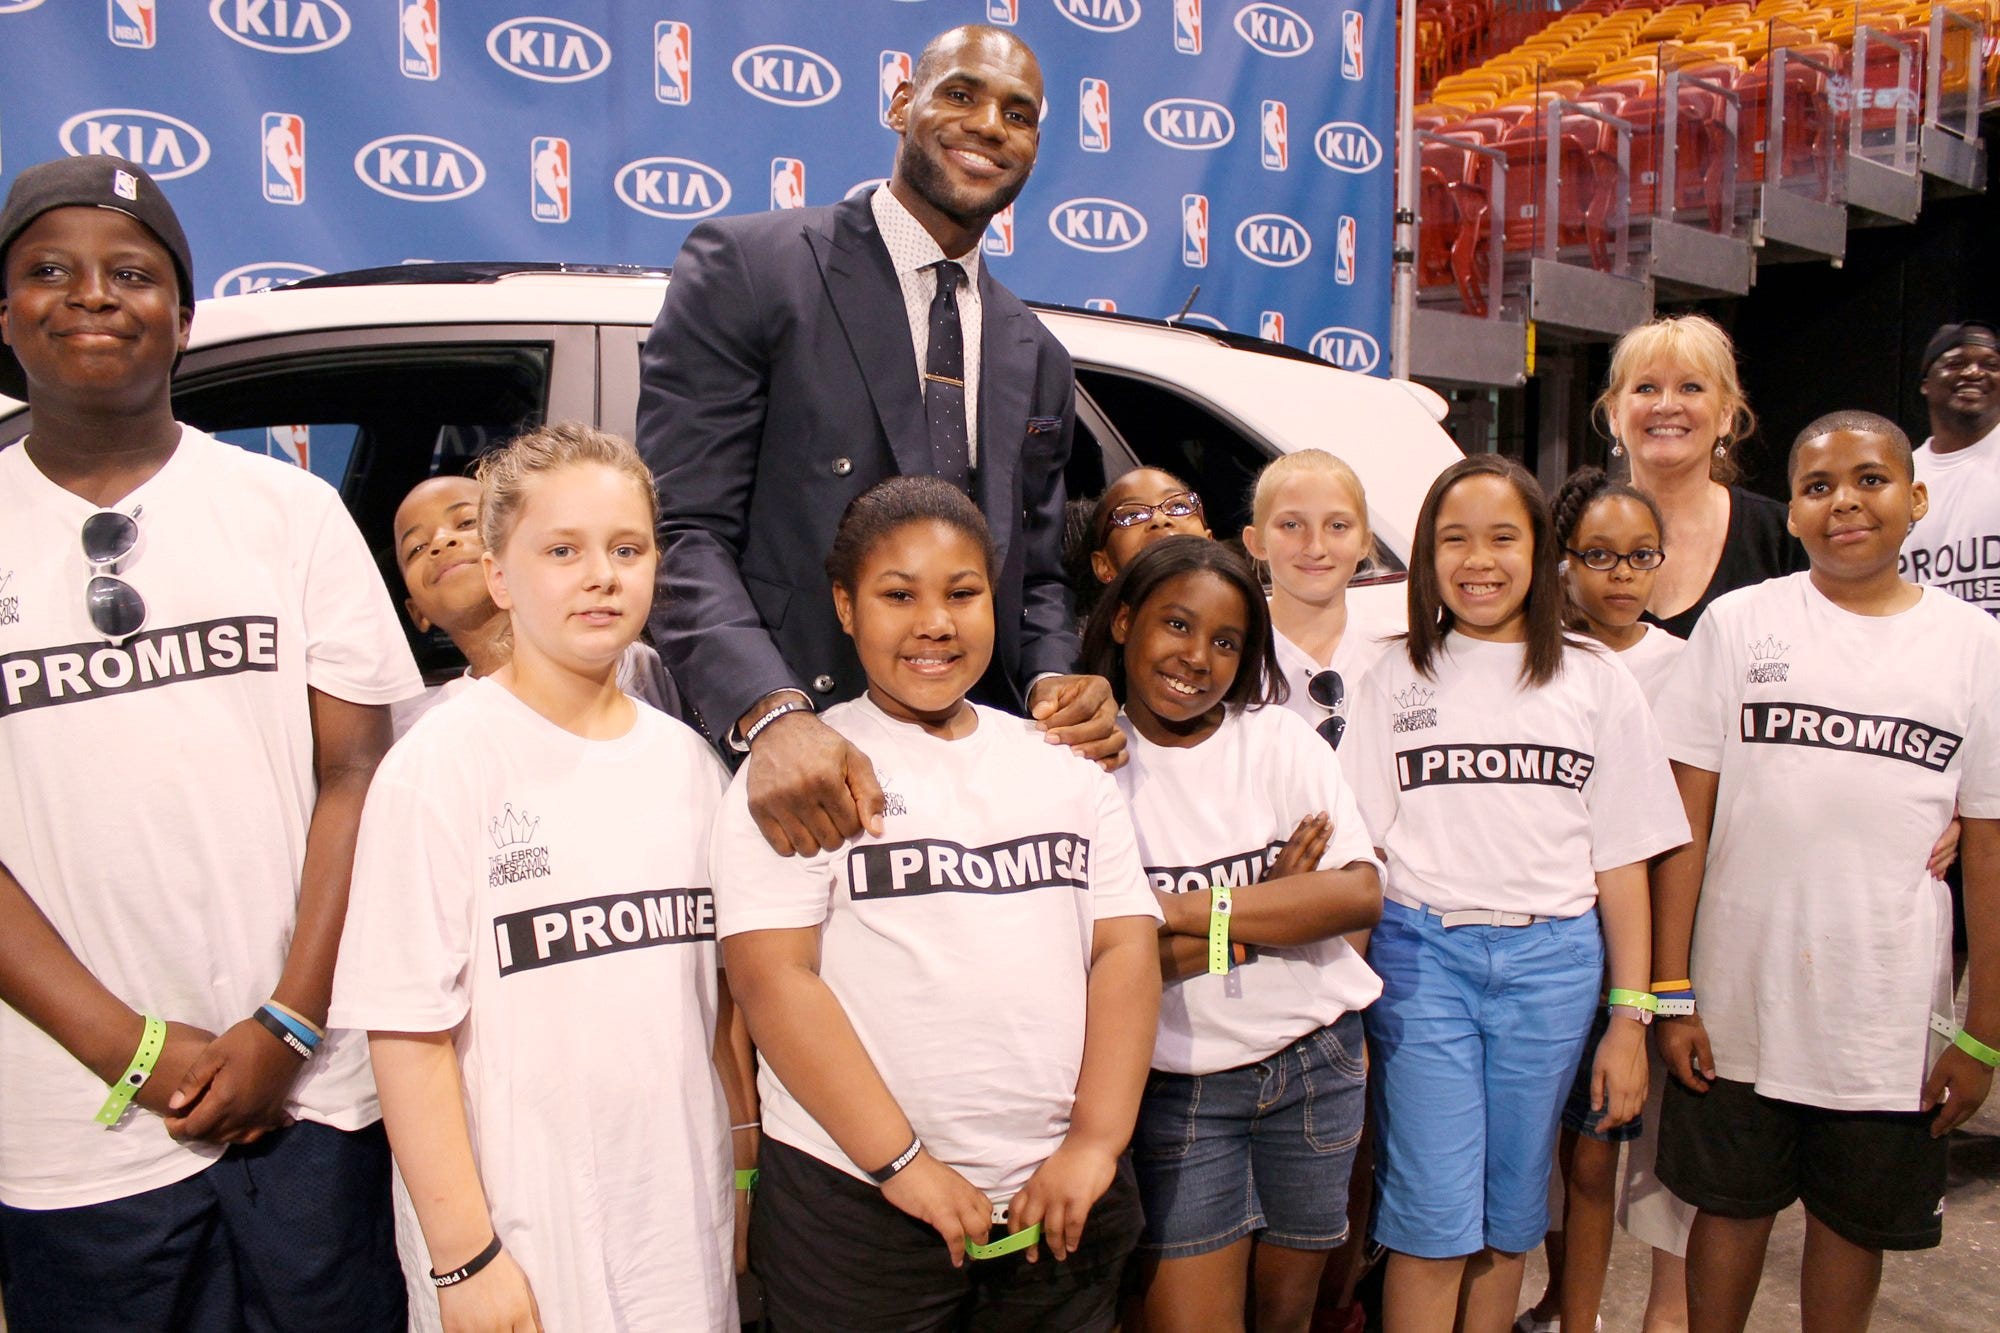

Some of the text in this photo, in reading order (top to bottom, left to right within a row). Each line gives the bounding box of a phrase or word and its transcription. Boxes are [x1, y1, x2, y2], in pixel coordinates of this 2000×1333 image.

[236, 0, 328, 40] KIA
[1250, 11, 1300, 49] KIA
[509, 28, 591, 71] KIA
[752, 55, 824, 96] KIA
[1160, 108, 1223, 139] KIA
[86, 121, 186, 168] KIA
[1326, 130, 1370, 165] KIA
[378, 147, 465, 190] KIA
[635, 168, 712, 208] KIA
[1066, 208, 1132, 241] KIA
[1249, 224, 1299, 257] KIA
[1320, 337, 1369, 367] KIA
[2, 623, 276, 706] PROMISE
[1743, 707, 1957, 767] I PROMISE
[1398, 748, 1593, 788] I PROMISE
[505, 845, 549, 863] LEBRON
[852, 838, 1088, 893] I PROMISE
[489, 865, 551, 888] FOUNDATION
[496, 895, 715, 969] I PROMISE
